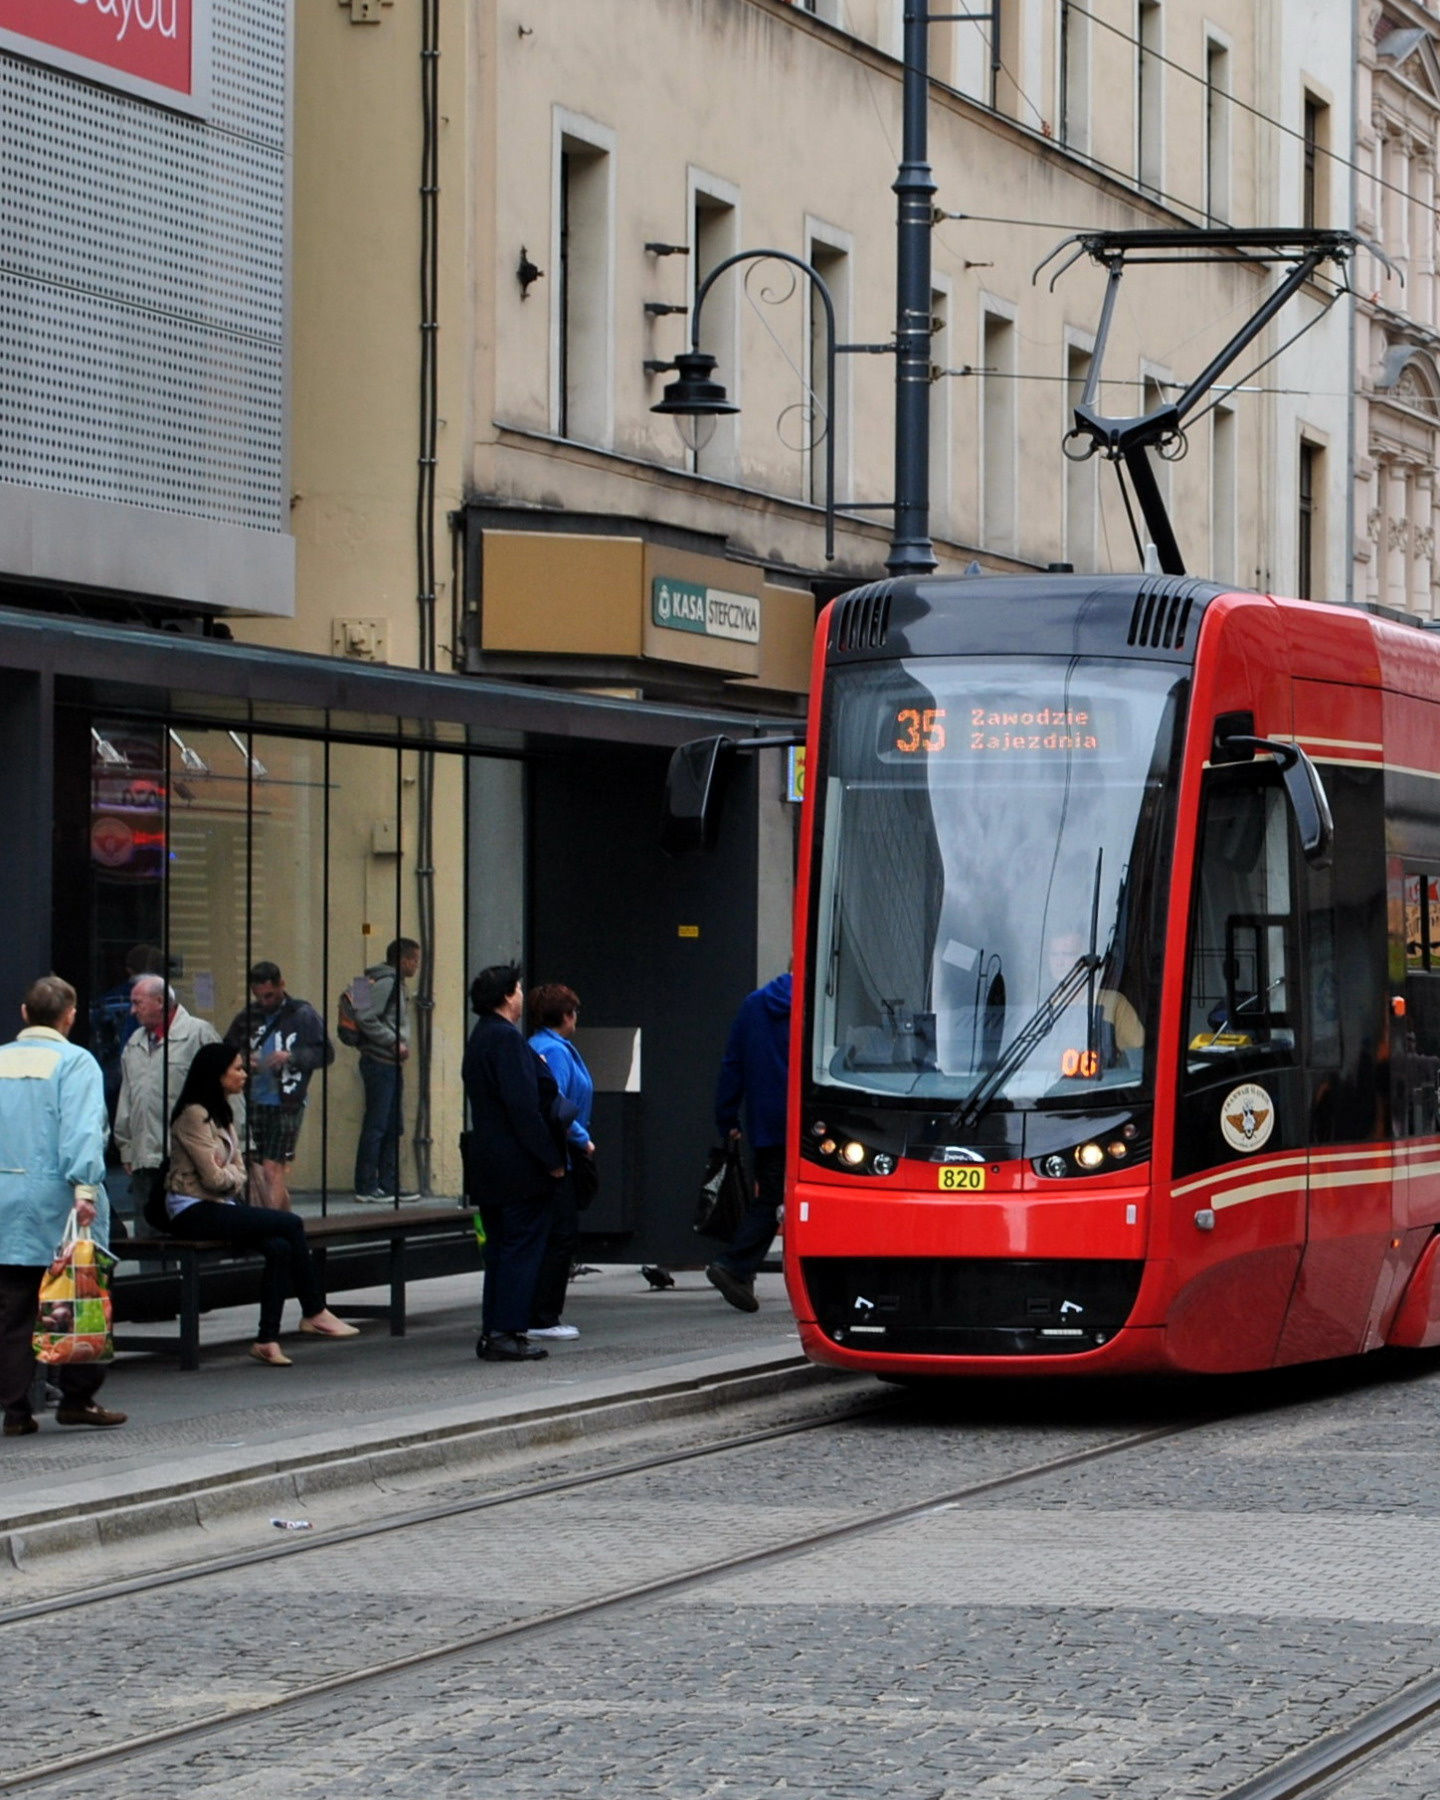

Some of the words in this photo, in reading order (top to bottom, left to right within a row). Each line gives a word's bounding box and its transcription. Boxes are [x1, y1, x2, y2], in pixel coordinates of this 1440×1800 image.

[672, 591, 704, 622] KASA
[708, 600, 757, 632] STEFCZYKA
[897, 709, 946, 752] 35
[971, 708, 1088, 726] Zawodzie
[970, 732, 1097, 752] Zajezdnia
[1062, 1048, 1097, 1077] 06
[943, 1169, 980, 1188] 820
